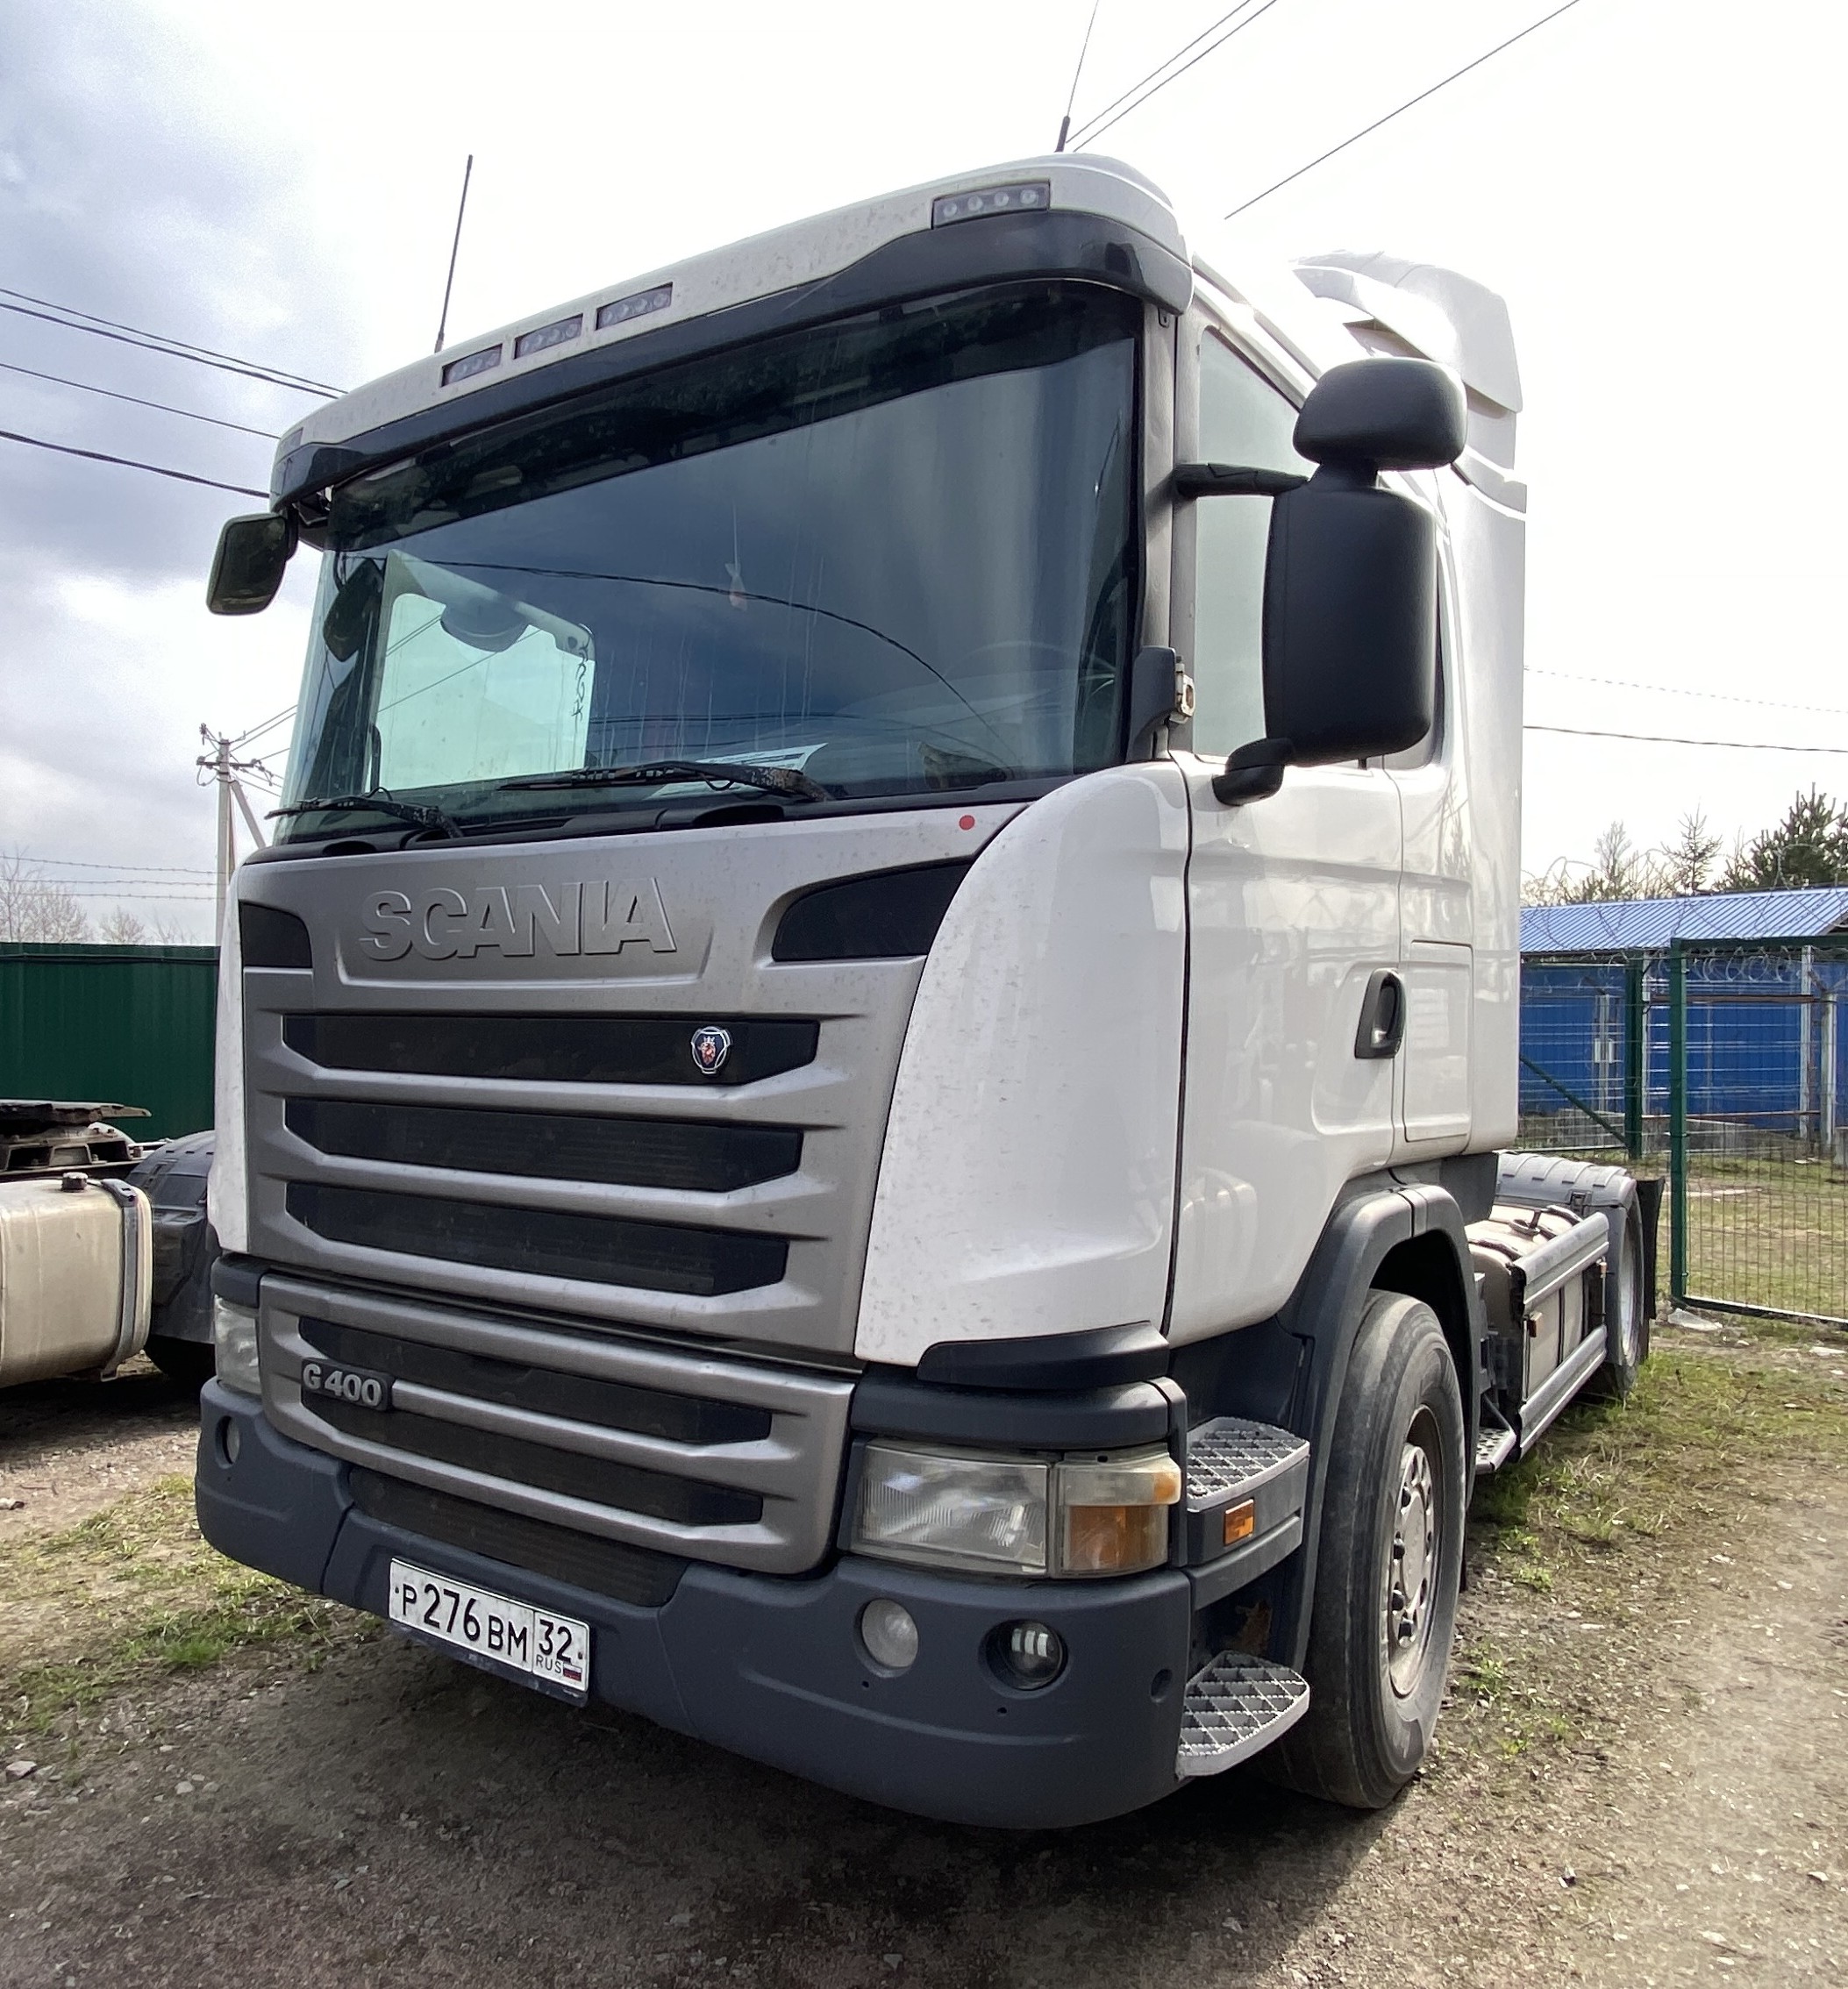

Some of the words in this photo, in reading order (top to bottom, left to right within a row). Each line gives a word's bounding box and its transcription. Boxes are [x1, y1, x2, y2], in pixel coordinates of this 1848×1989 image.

[359, 877, 677, 961] SCANIA
[303, 1363, 322, 1390] G
[325, 1370, 382, 1406] 400
[535, 1654, 562, 1675] RUS
